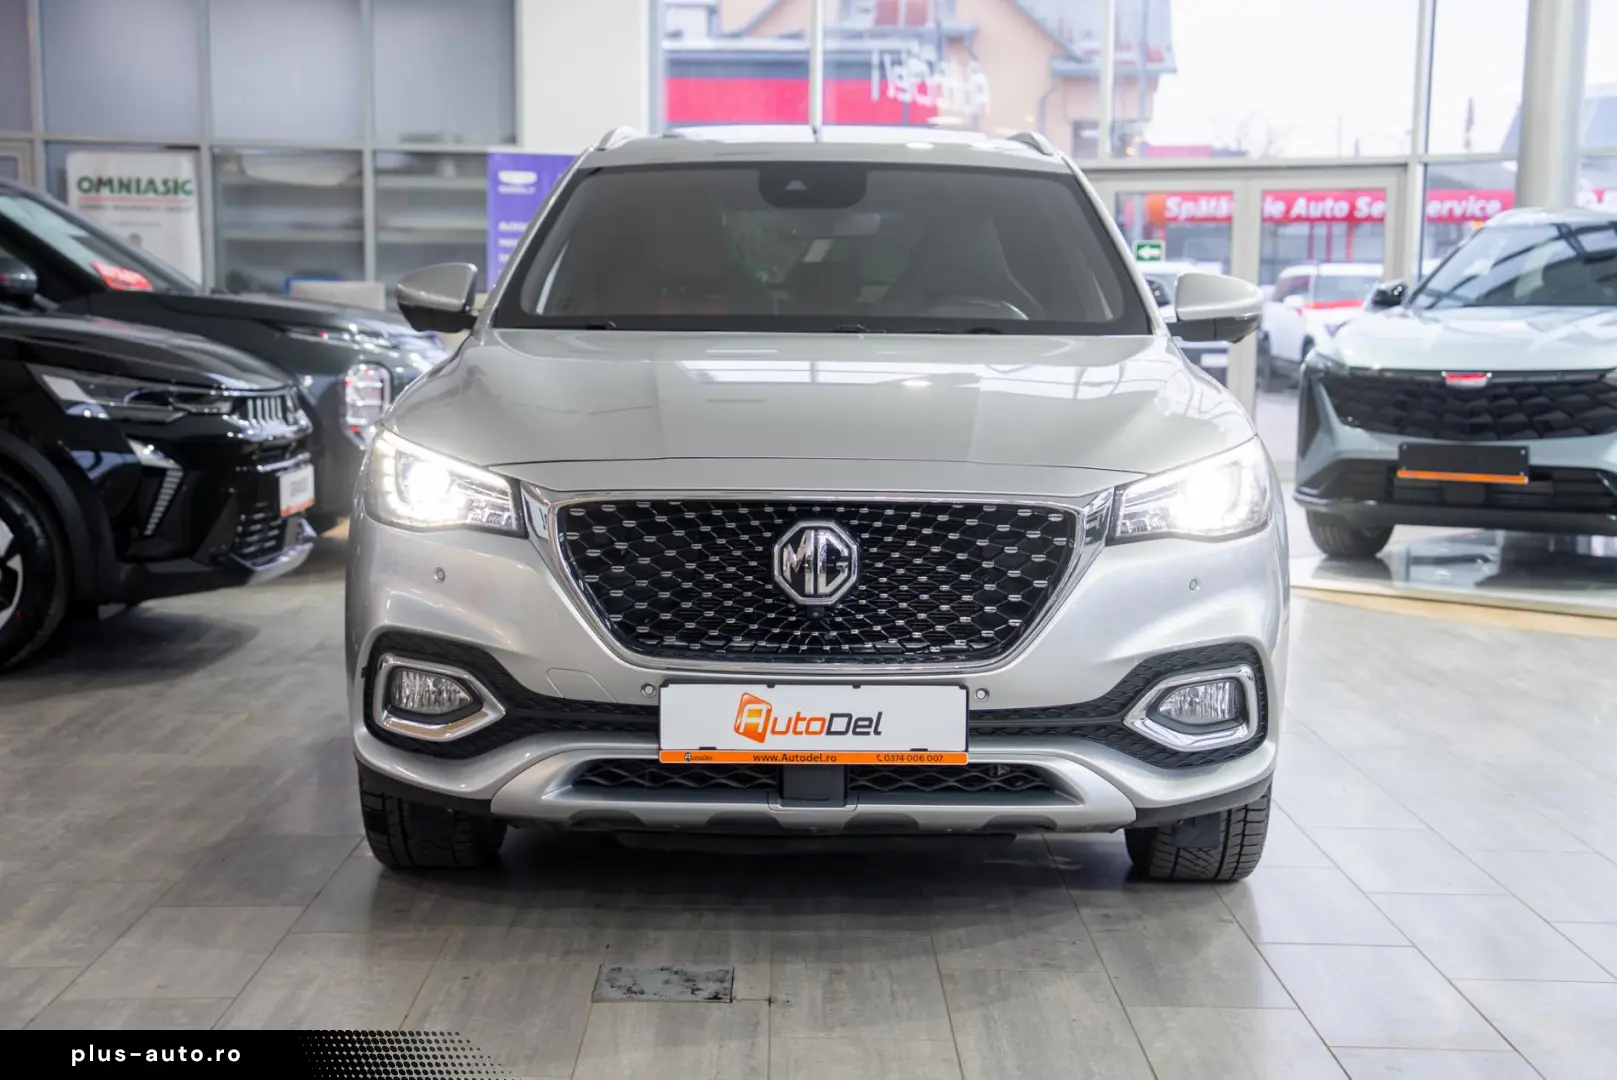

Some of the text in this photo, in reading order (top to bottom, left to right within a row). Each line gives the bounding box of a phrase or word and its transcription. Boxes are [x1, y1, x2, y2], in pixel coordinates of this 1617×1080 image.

[1290, 197, 1350, 219] Auto
[782, 529, 849, 595] MG
[733, 692, 883, 743] AutoDel
[752, 753, 838, 763] www.Autodel.ro
[883, 754, 905, 763] 0374
[906, 754, 925, 763] 006
[926, 754, 944, 763] 007
